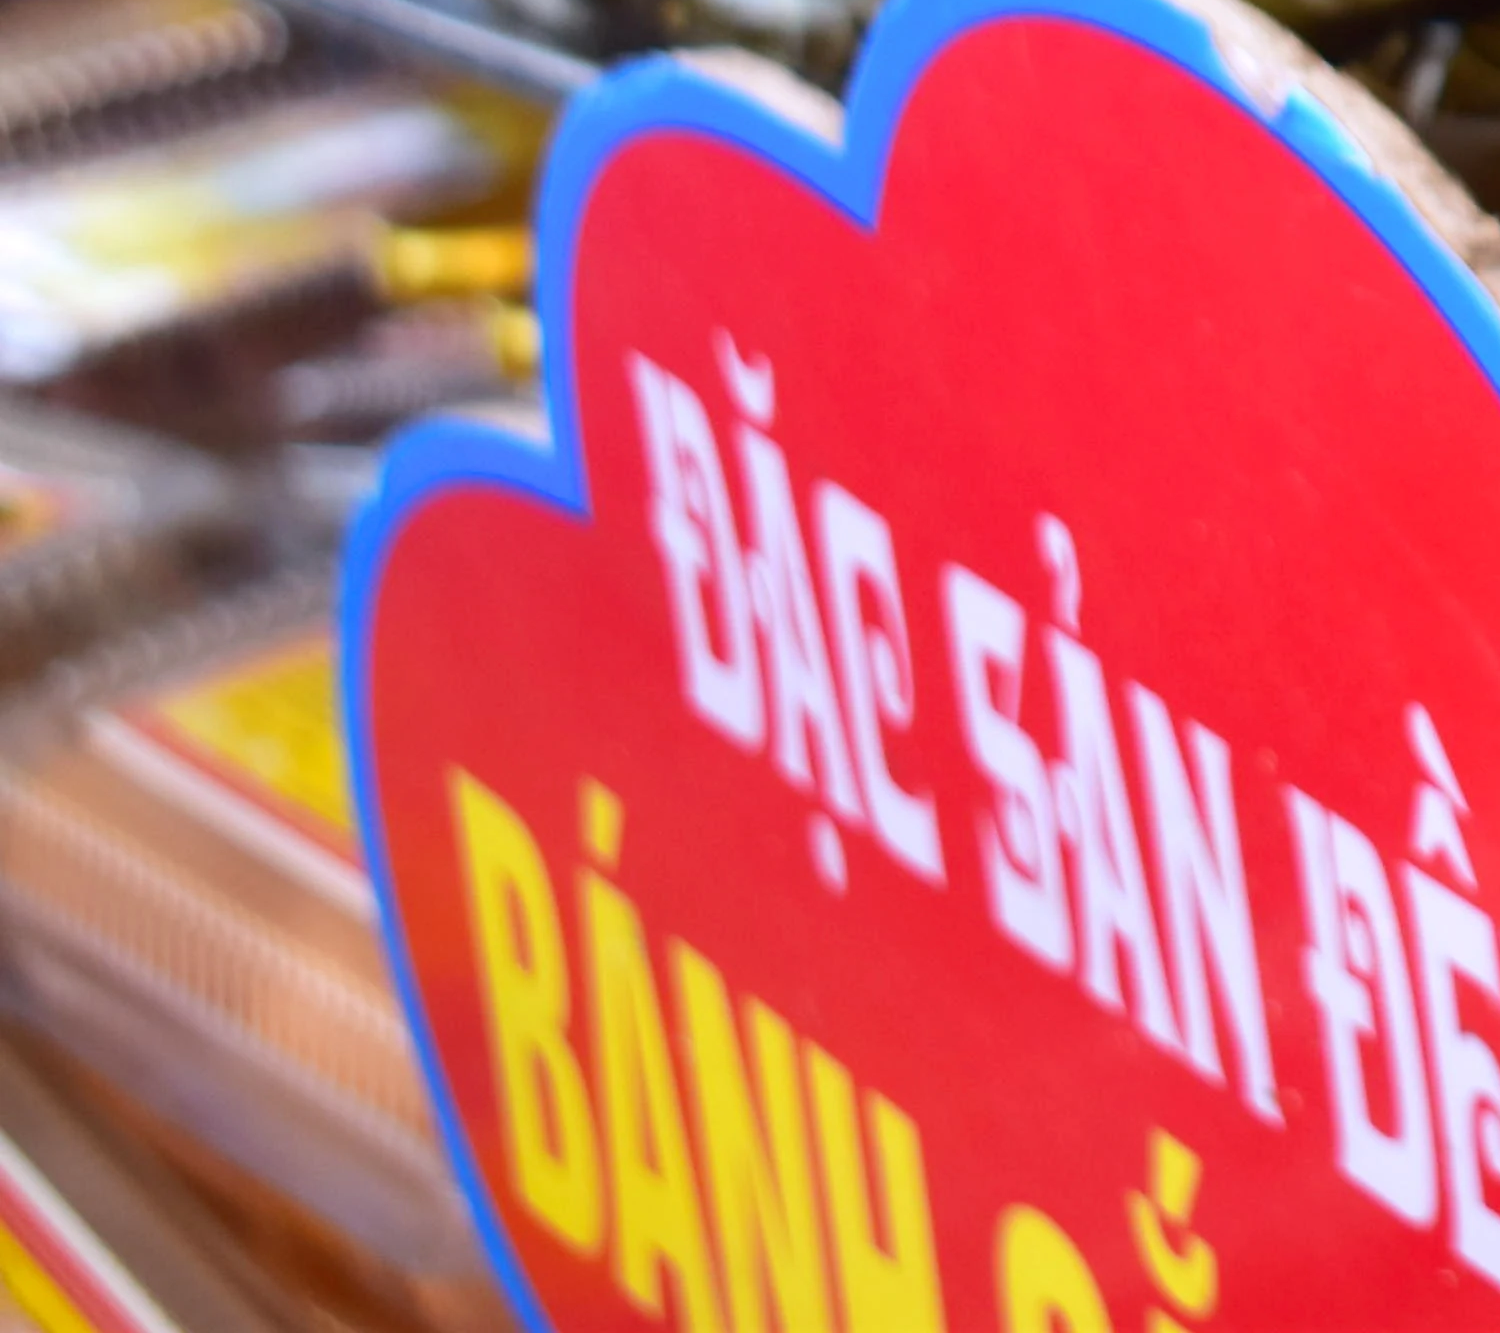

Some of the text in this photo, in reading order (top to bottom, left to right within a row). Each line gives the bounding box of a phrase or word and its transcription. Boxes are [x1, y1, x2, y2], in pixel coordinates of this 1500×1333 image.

[448, 763, 950, 1333] BÁNH
[628, 329, 947, 897] ĐẶC
[943, 513, 1286, 1127] SẢN
